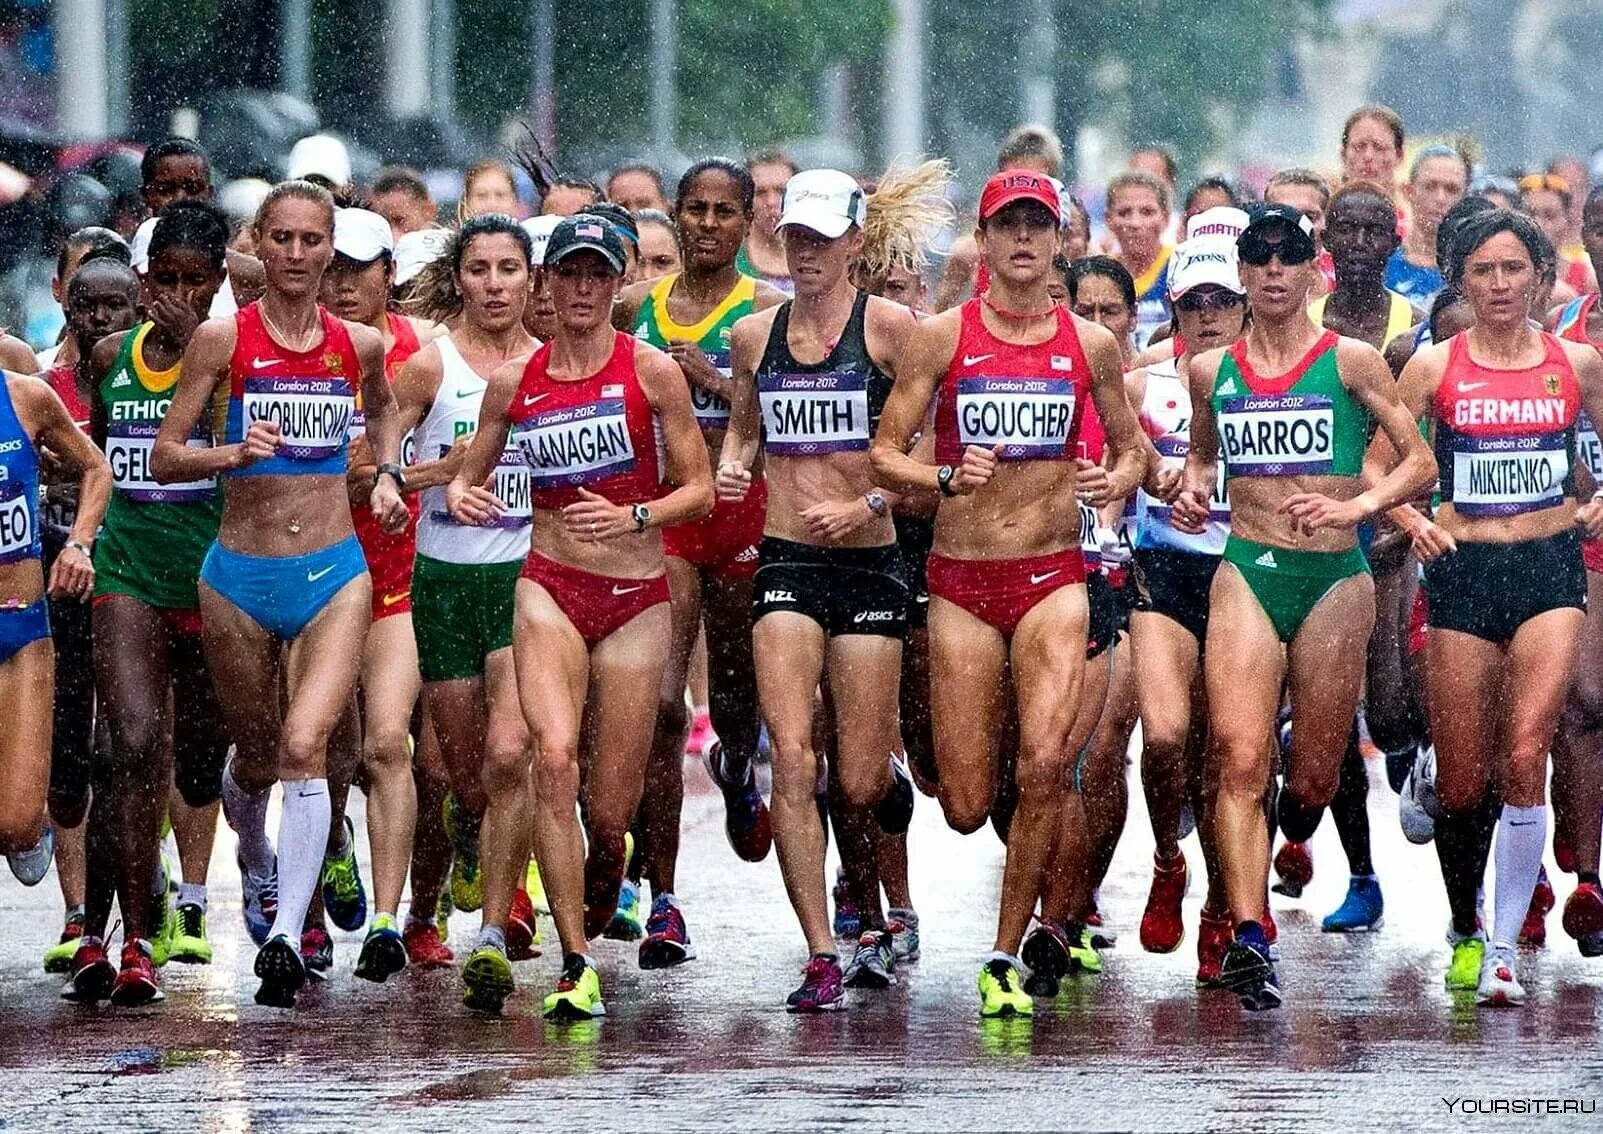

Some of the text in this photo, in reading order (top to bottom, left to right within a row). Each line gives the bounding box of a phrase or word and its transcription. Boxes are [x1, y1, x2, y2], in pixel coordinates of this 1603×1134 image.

[1002, 175, 1041, 191] USA
[1182, 251, 1228, 271] JAPAN
[273, 380, 332, 393] London 2012
[782, 377, 838, 389] London 2012
[986, 380, 1048, 392] London 2012
[1244, 398, 1304, 410] London 2012
[537, 405, 598, 427] London 2012
[772, 398, 854, 436] SMITH
[962, 401, 1070, 439] GOUCHER
[1454, 399, 1566, 426] GERMANY
[1224, 418, 1330, 457] BARROS
[1478, 437, 1540, 450] London 2012
[1468, 457, 1552, 496] MIKITENKO
[763, 590, 798, 604] NZL
[866, 609, 894, 622] asics
